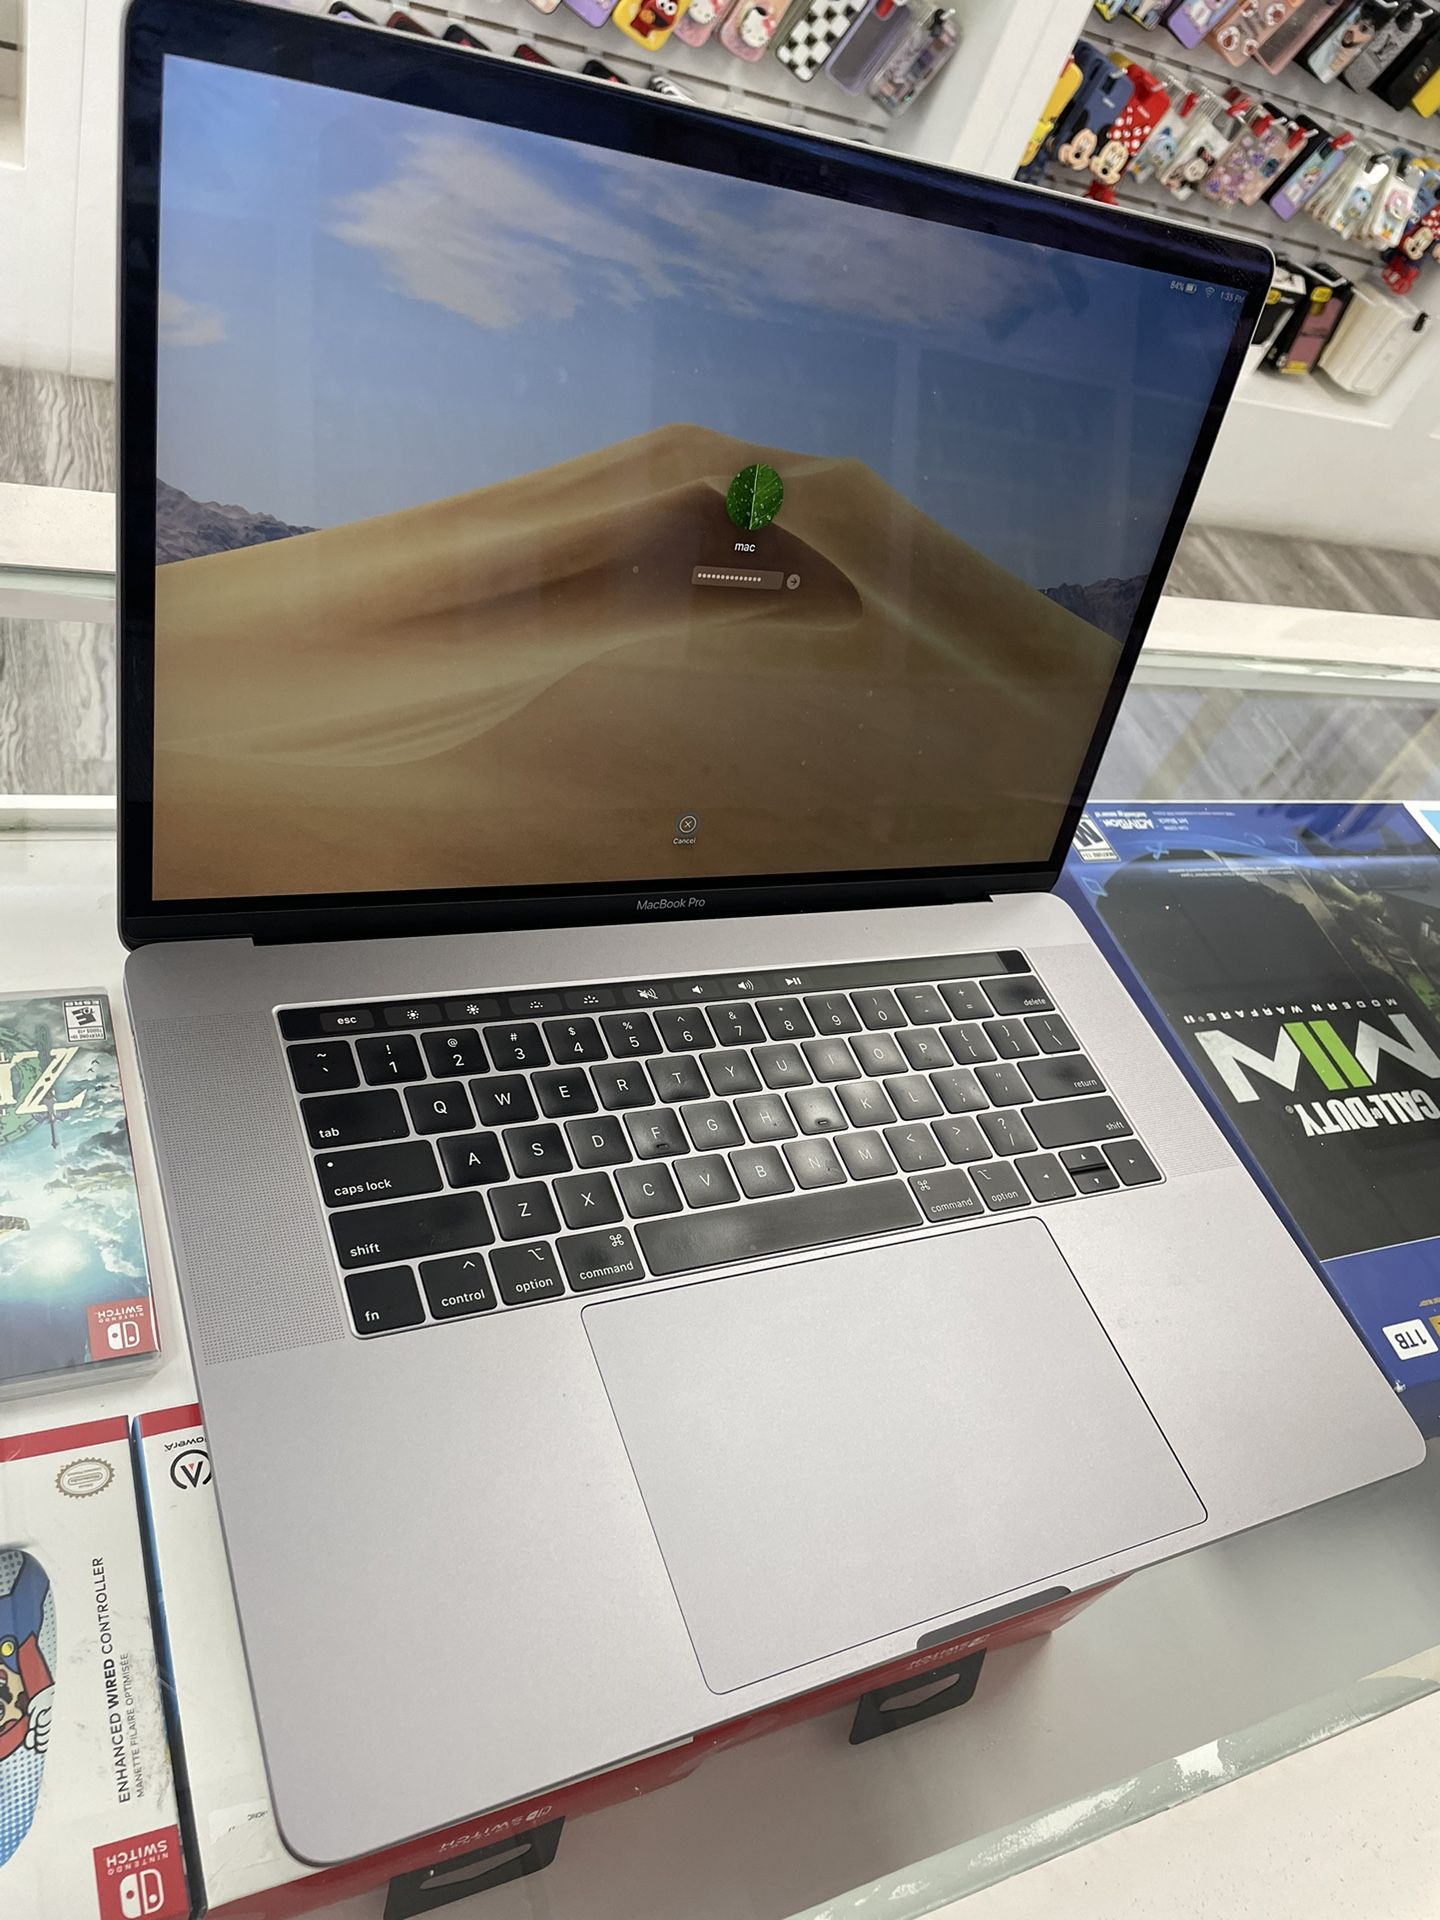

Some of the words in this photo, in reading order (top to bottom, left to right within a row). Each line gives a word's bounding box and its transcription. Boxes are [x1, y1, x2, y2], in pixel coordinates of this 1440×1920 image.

[734, 541, 756, 553] mac
[673, 837, 696, 845] Cancel
[636, 898, 685, 911] MacBook
[688, 897, 706, 908] Pro
[1023, 997, 1046, 1006] delete
[1310, 997, 1397, 1012] MODERN
[337, 1015, 357, 1025] esc
[878, 1010, 888, 1021] 0
[1206, 1004, 1303, 1022] WARFARE
[784, 1020, 794, 1031] 8
[831, 1015, 842, 1026] 9
[509, 1032, 519, 1042] #
[567, 1026, 576, 1037] $
[683, 1030, 693, 1042] 6
[734, 1025, 742, 1036] 7
[447, 1037, 458, 1048] @
[573, 1041, 584, 1055] 4
[629, 1035, 640, 1049] 5
[918, 1043, 928, 1053] P
[455, 1054, 465, 1067] 2
[515, 1047, 526, 1061] 3
[873, 1048, 884, 1060] O
[388, 1061, 399, 1074] 1
[724, 1066, 735, 1078] Y
[776, 1060, 788, 1071] U
[616, 1078, 629, 1092] R
[671, 1072, 681, 1084] T
[1074, 1078, 1097, 1088] return
[558, 1085, 570, 1098] E
[908, 1091, 919, 1103] L
[495, 1092, 512, 1106] W
[861, 1098, 872, 1110] K
[434, 1100, 448, 1115] Q
[1366, 1088, 1440, 1125] CALL
[759, 1112, 772, 1124] H
[1293, 1096, 1378, 1137] DUTY
[707, 1119, 718, 1131] G
[1105, 1120, 1125, 1131] shift
[319, 1127, 340, 1138] tab
[651, 1127, 661, 1140] F
[592, 1135, 605, 1148] D
[531, 1142, 544, 1157] S
[857, 1148, 873, 1161] M
[468, 1151, 481, 1167] A
[809, 1157, 821, 1169] N
[755, 1165, 767, 1178] B
[699, 1173, 711, 1187] V
[334, 1181, 365, 1198] caps
[366, 1178, 392, 1191] lock
[642, 1183, 655, 1197] C
[581, 1192, 595, 1207] X
[991, 1190, 1019, 1203] option
[518, 1202, 532, 1217] Z
[931, 1198, 973, 1213] command
[349, 1242, 381, 1259] shift
[579, 1260, 634, 1281] command
[515, 1276, 554, 1295] option
[441, 1289, 486, 1308] control
[97, 1304, 143, 1318] SWITCH
[98, 1312, 144, 1323] NINTENDO
[365, 1308, 380, 1322] fn
[1394, 1329, 1427, 1350] 1TB
[164, 1436, 206, 1451] owerA
[92, 1557, 113, 1654] CONTROLLER
[103, 1658, 119, 1709] WIRED
[119, 1653, 135, 1706] OPTIMISÉE
[126, 1708, 138, 1746] FILAIRE
[109, 1712, 131, 1803] ENHANCED
[130, 1748, 145, 1798] MANETTE
[106, 1840, 168, 1868] SWITCH
[107, 1852, 169, 1876] NINTENDO
